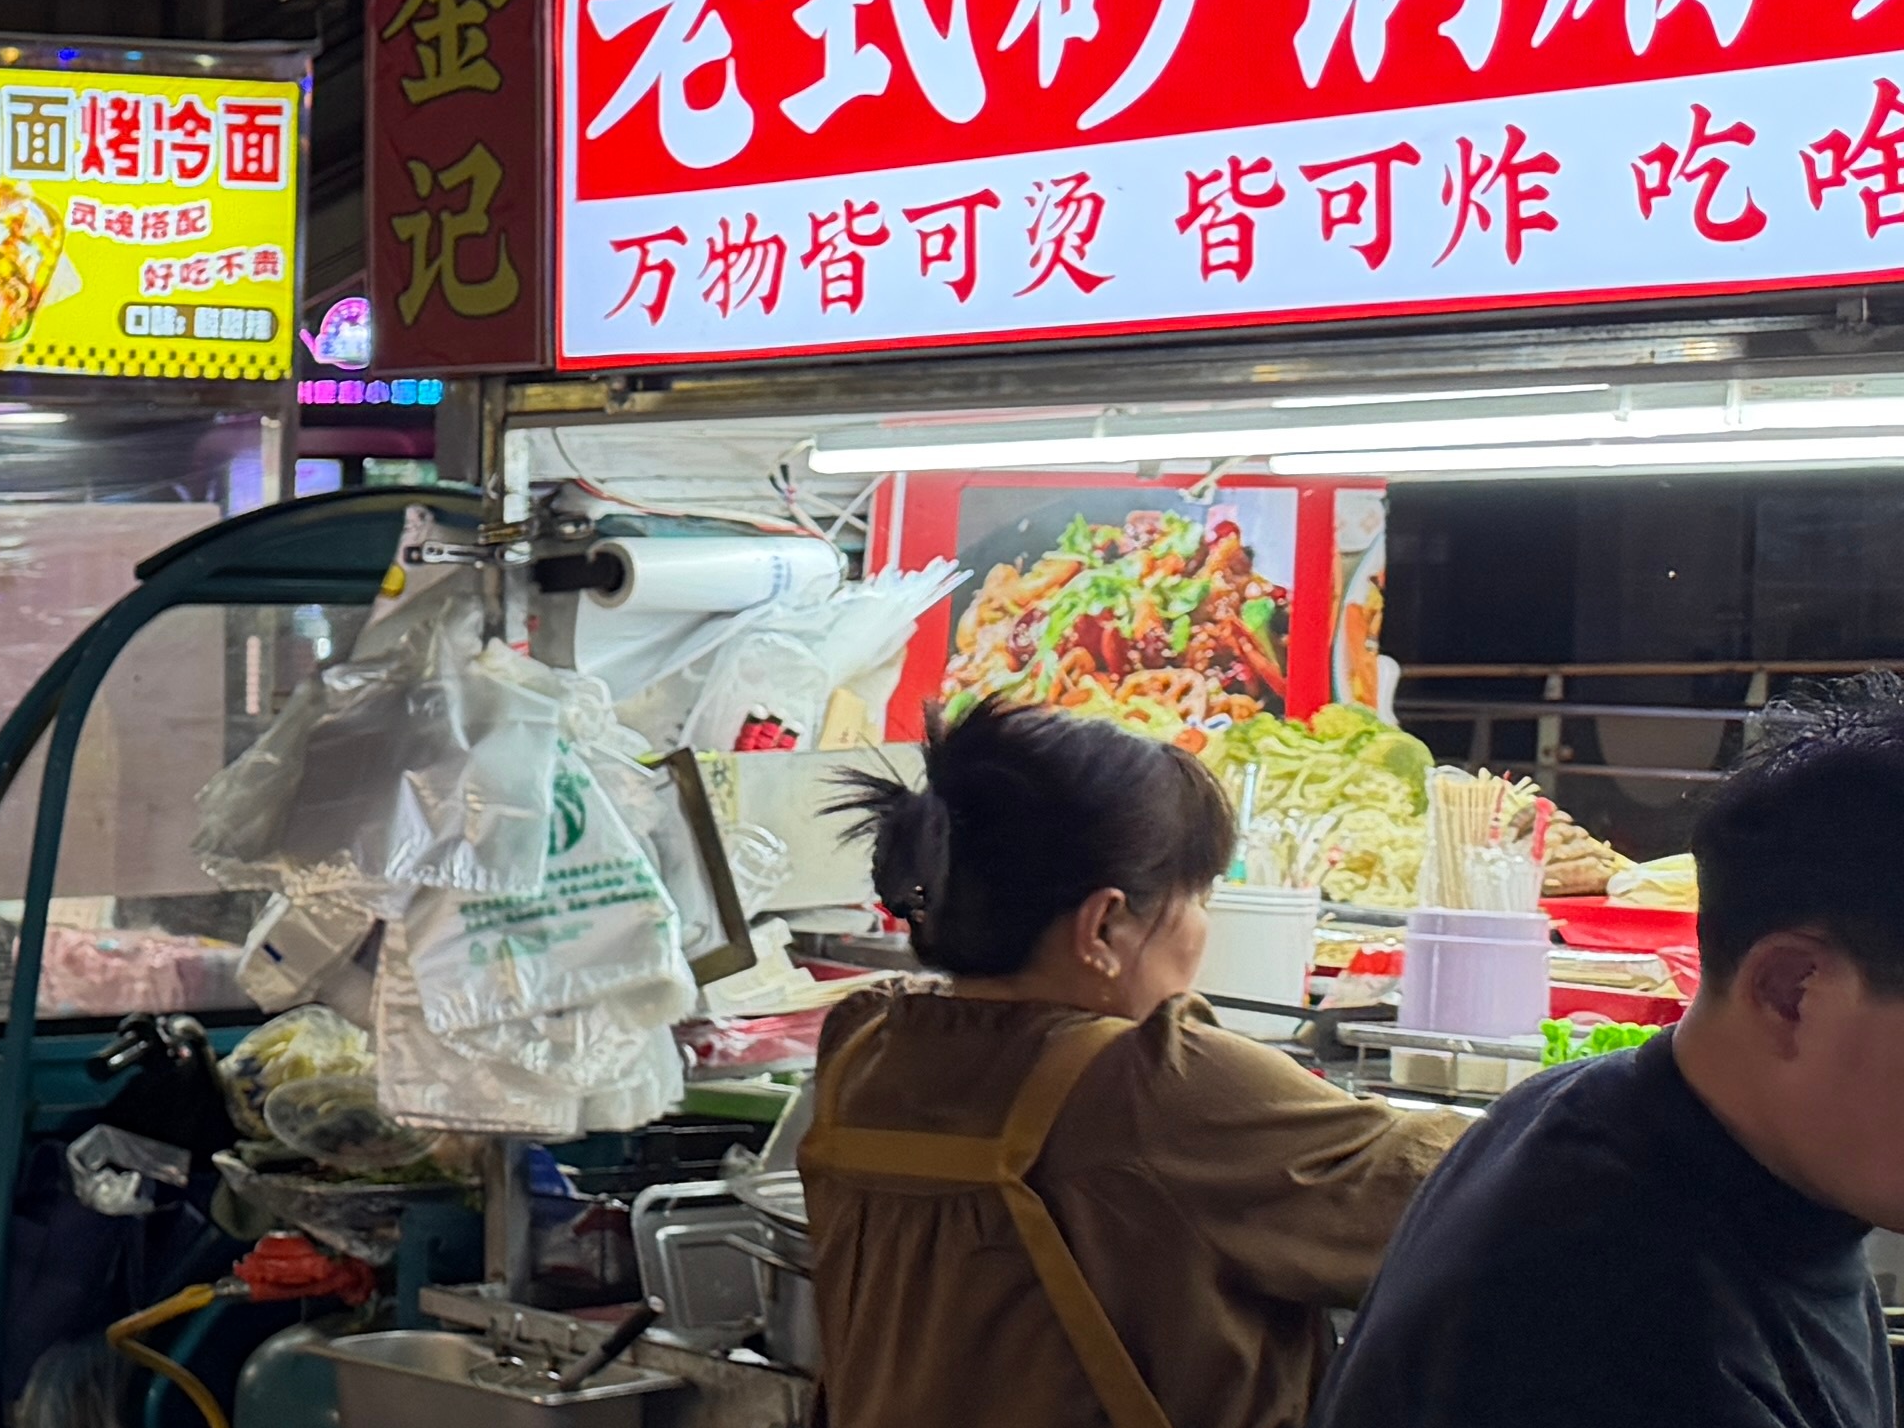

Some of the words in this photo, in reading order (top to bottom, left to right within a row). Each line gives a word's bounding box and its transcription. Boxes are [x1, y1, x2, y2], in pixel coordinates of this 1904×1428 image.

[70, 201, 207, 240] 灵魂搭配
[604, 171, 1117, 326] 万物皆可烫
[1176, 123, 1562, 283] 皆可炸
[1629, 76, 1904, 241] 吃啥
[143, 249, 279, 292] 好吃不贵
